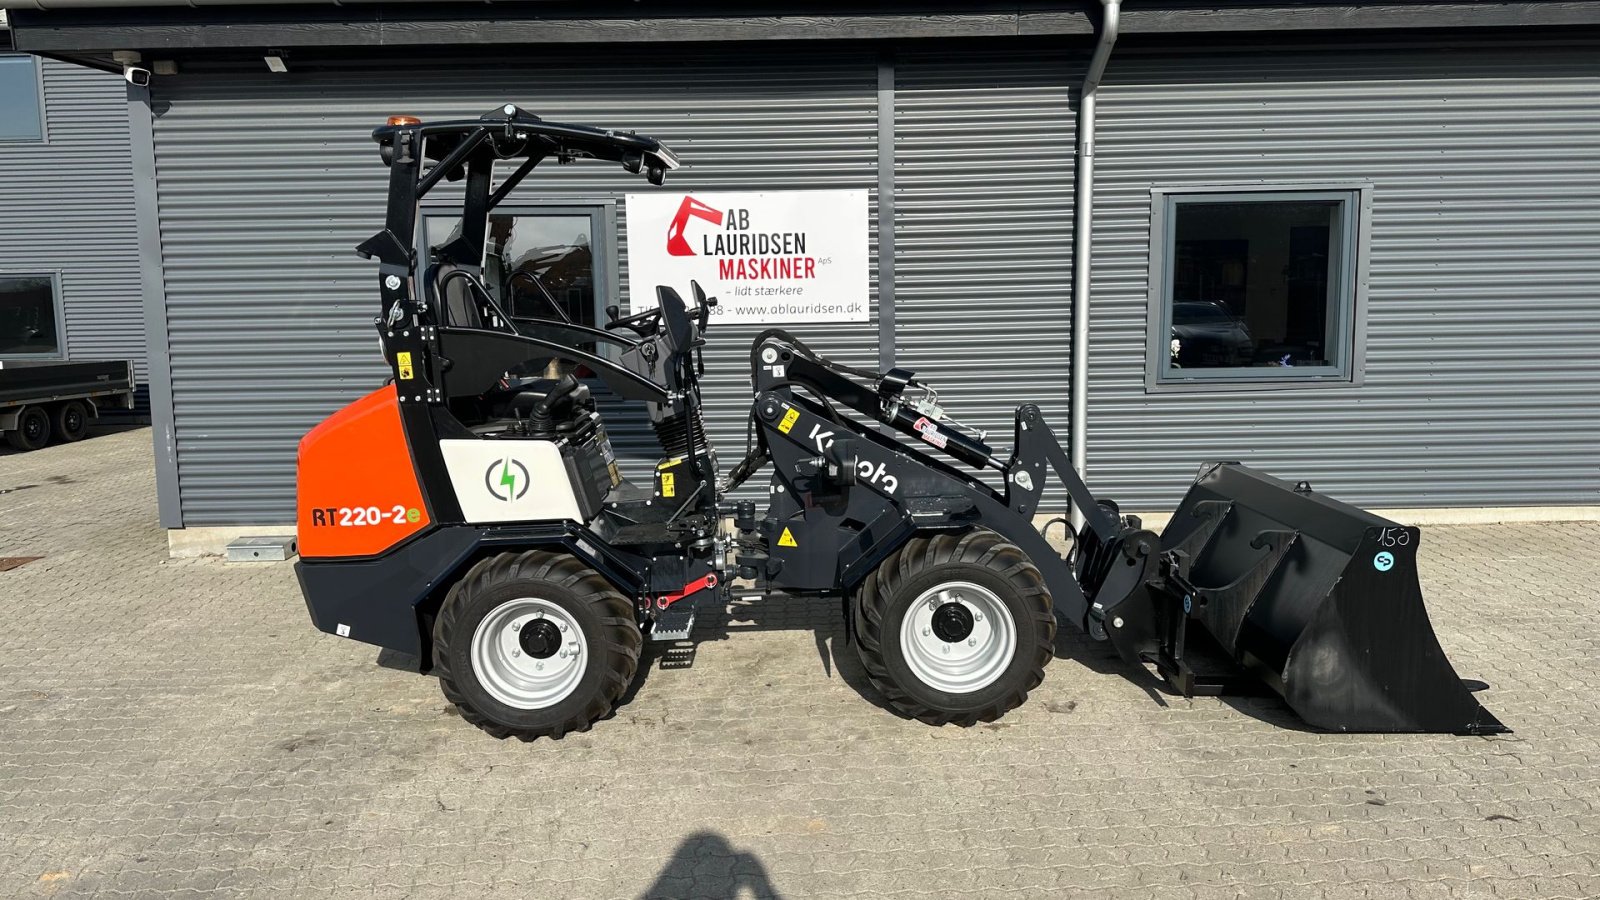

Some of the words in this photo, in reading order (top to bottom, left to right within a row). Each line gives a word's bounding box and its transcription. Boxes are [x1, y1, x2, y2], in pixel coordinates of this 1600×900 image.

[726, 208, 750, 231] AB
[703, 232, 806, 256] LAURIDSEN
[719, 257, 816, 280] MASKINER
[817, 257, 832, 265] ApS
[734, 286, 752, 297] lidt
[754, 285, 804, 296] stærkere
[735, 302, 862, 315] www.ablauridsen.dk
[808, 423, 899, 495] Kota
[312, 504, 421, 527] RT220-2e
